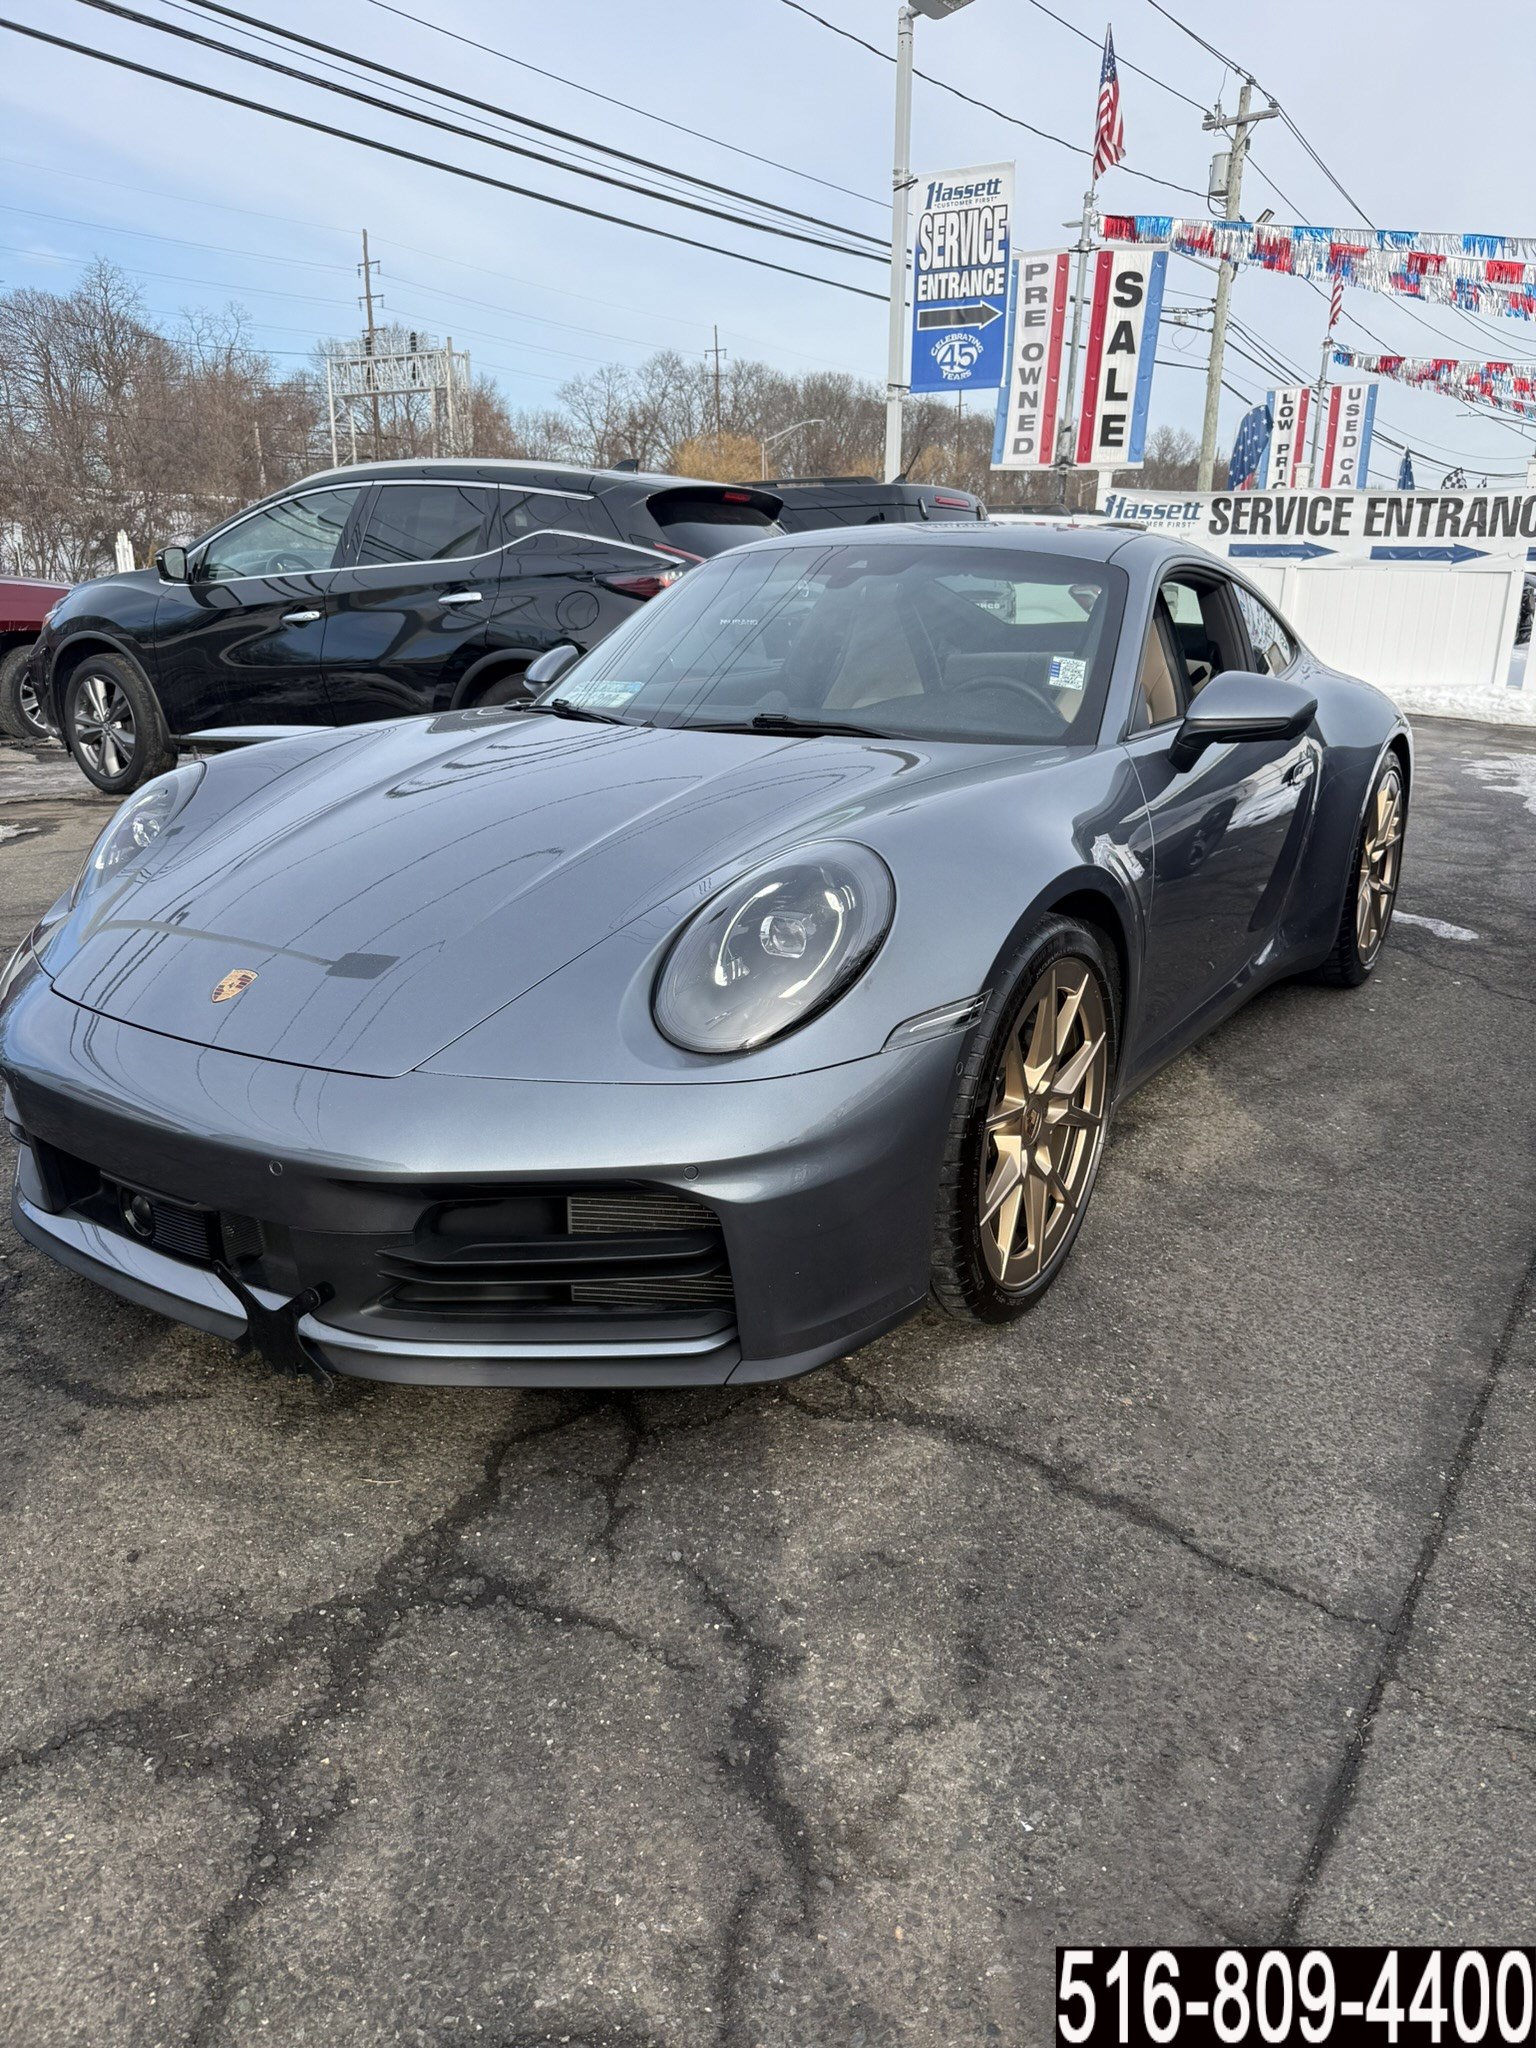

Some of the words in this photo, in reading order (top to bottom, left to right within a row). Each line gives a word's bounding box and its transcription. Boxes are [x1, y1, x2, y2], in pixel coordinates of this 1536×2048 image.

[918, 204, 1008, 272] SERVICE
[917, 267, 1005, 302] ENTRANCE
[1024, 262, 1049, 328] PRE
[930, 332, 984, 357] CELEBRATING
[939, 343, 975, 371] 45
[1099, 270, 1144, 447] SALE
[942, 370, 972, 380] YEARS
[1012, 343, 1045, 455] OWNED
[1277, 393, 1294, 431] LOW
[1342, 387, 1362, 448] USED
[1208, 496, 1352, 537] SERVICE
